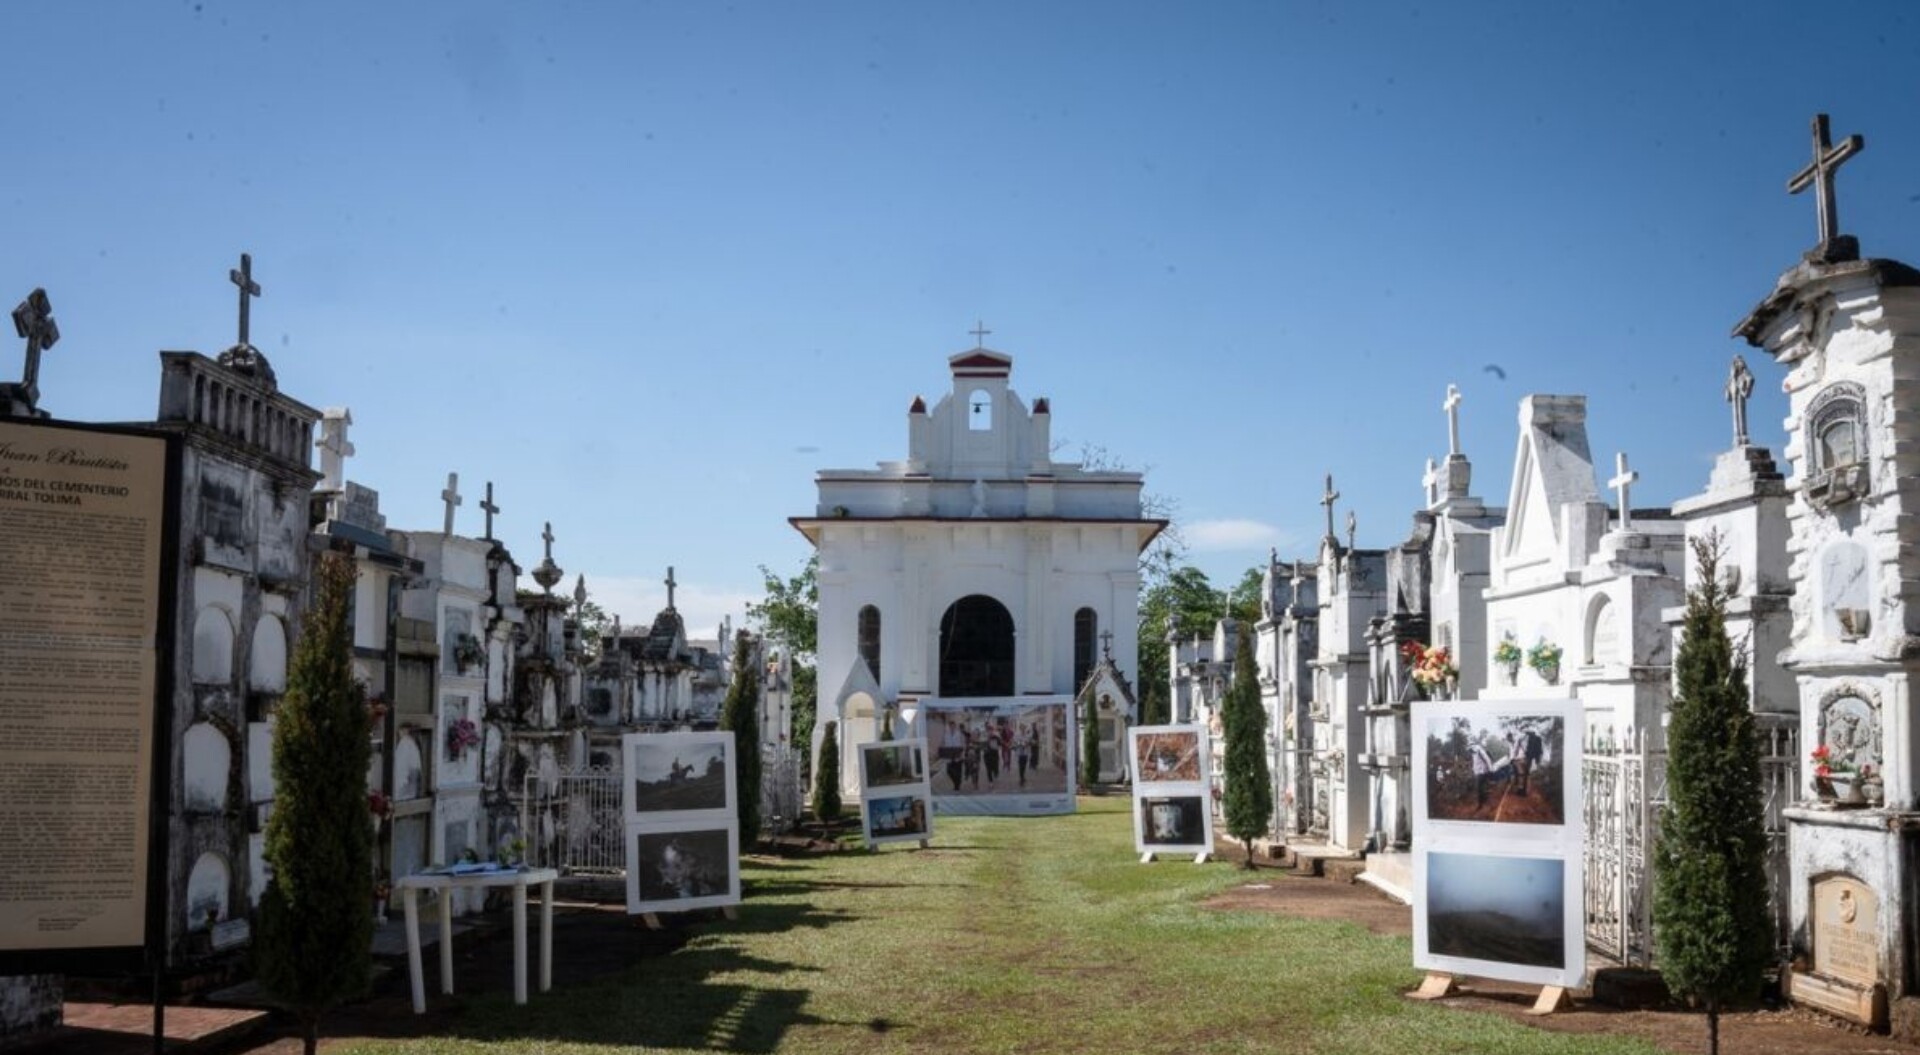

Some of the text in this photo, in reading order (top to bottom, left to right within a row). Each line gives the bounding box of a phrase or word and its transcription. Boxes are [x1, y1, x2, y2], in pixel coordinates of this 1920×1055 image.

[23, 477, 46, 490] DEL
[49, 481, 130, 497] CEMENTERIO
[34, 492, 82, 505] TOLIMA
